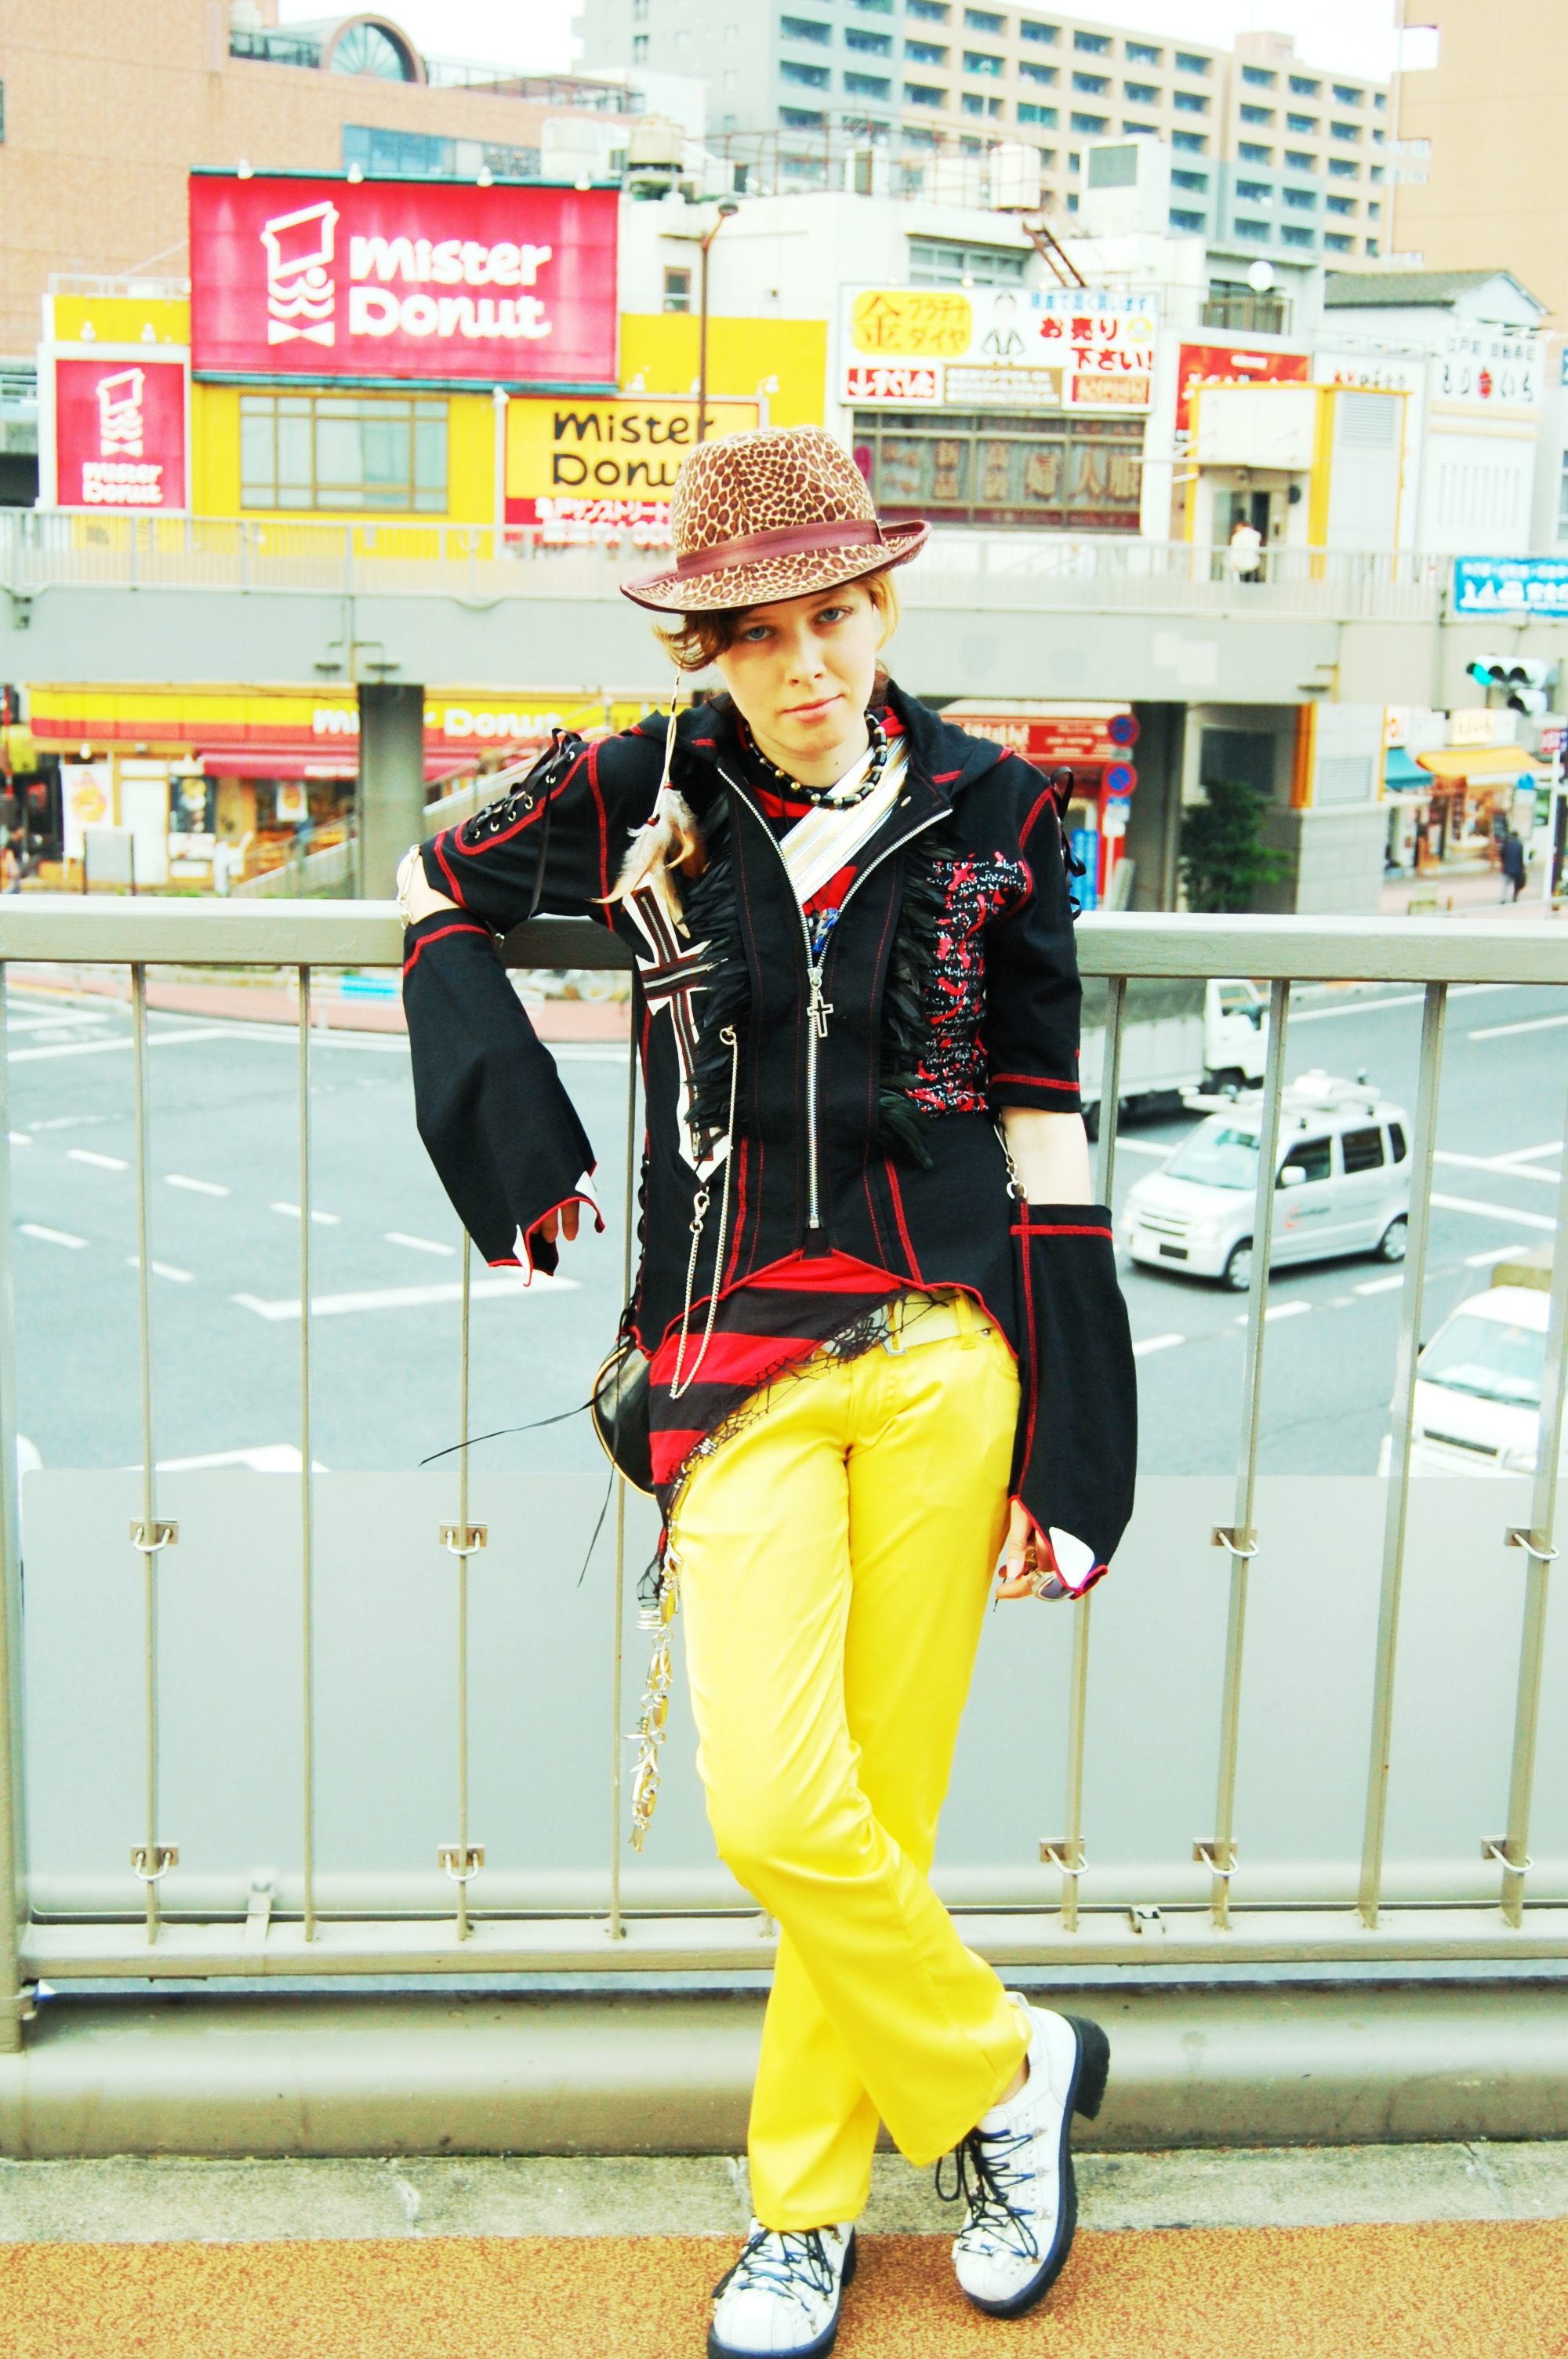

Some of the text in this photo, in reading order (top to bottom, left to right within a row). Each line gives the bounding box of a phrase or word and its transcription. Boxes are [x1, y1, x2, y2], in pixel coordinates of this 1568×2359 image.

[350, 236, 552, 285] Mister
[349, 286, 552, 339] Donut
[857, 296, 901, 348] 金
[1040, 316, 1117, 341] お売り
[553, 453, 681, 486] Donu
[444, 708, 564, 737] Donut
